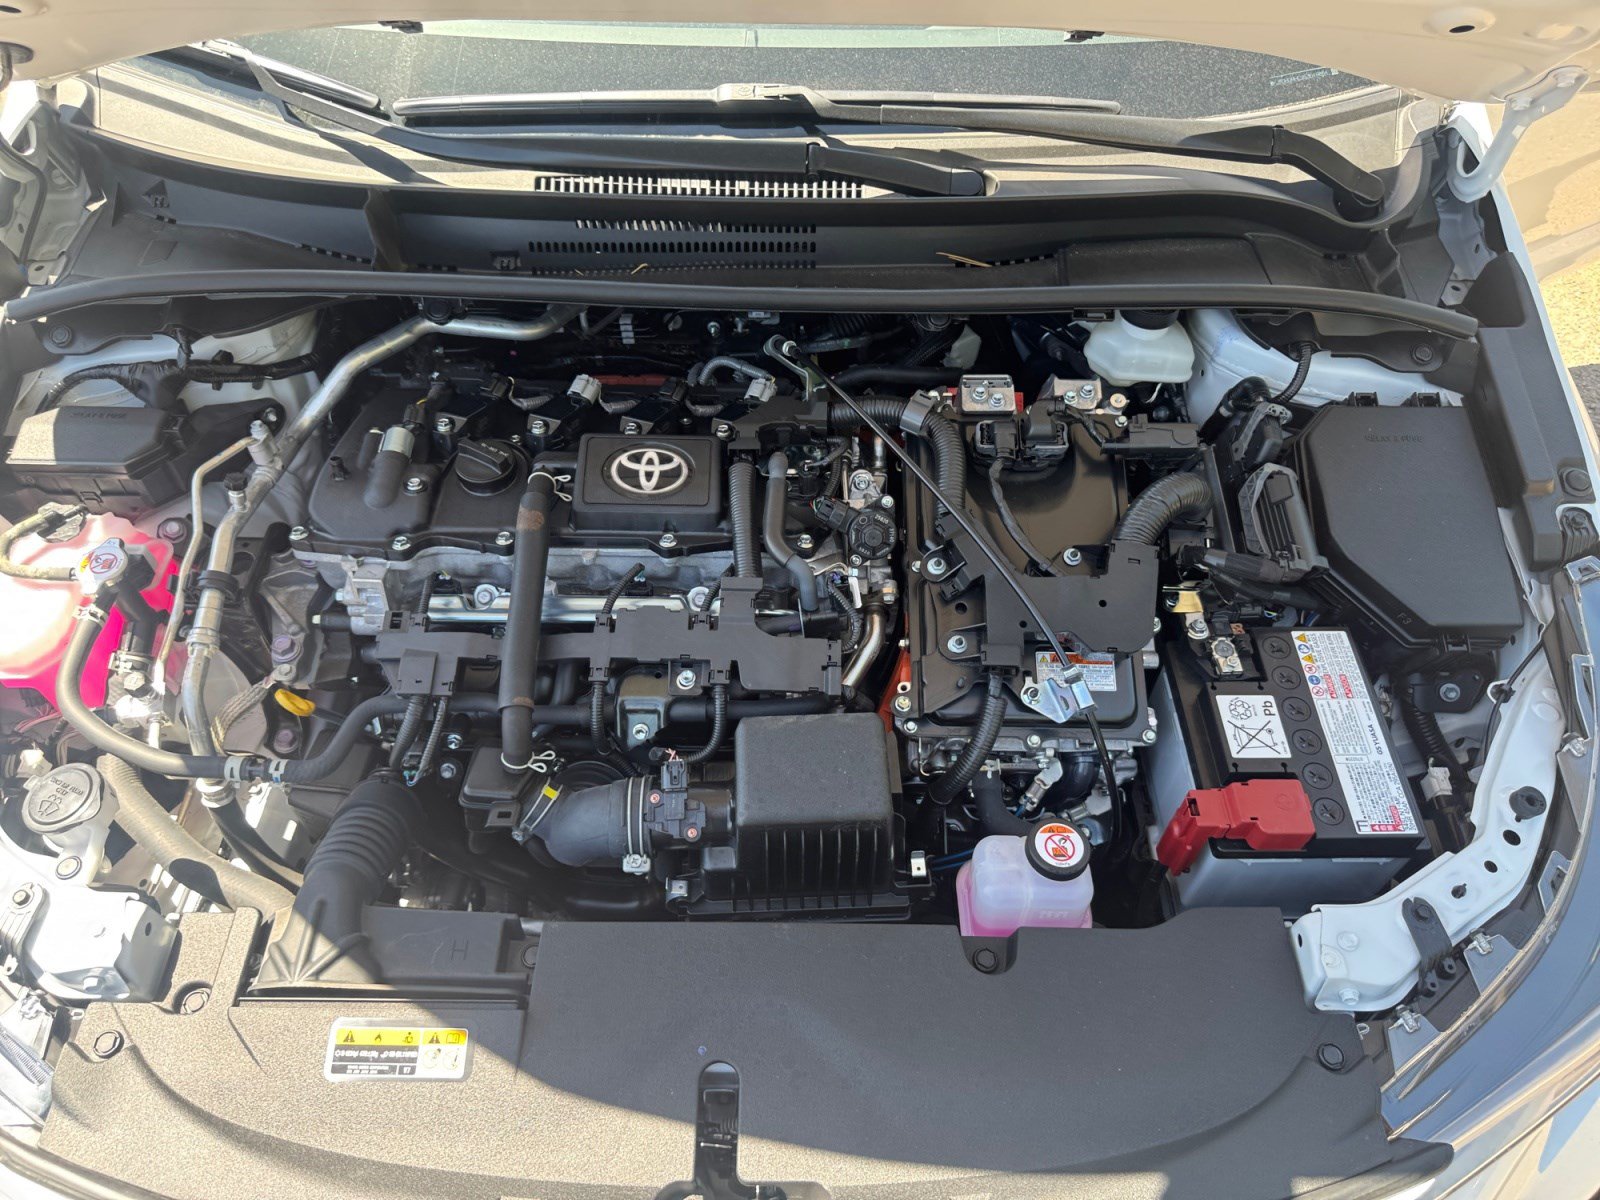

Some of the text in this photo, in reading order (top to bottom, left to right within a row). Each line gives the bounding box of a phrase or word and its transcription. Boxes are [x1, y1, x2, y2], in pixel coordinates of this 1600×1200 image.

[1262, 700, 1275, 716] Pb
[1366, 723, 1383, 754] GS YUASA
